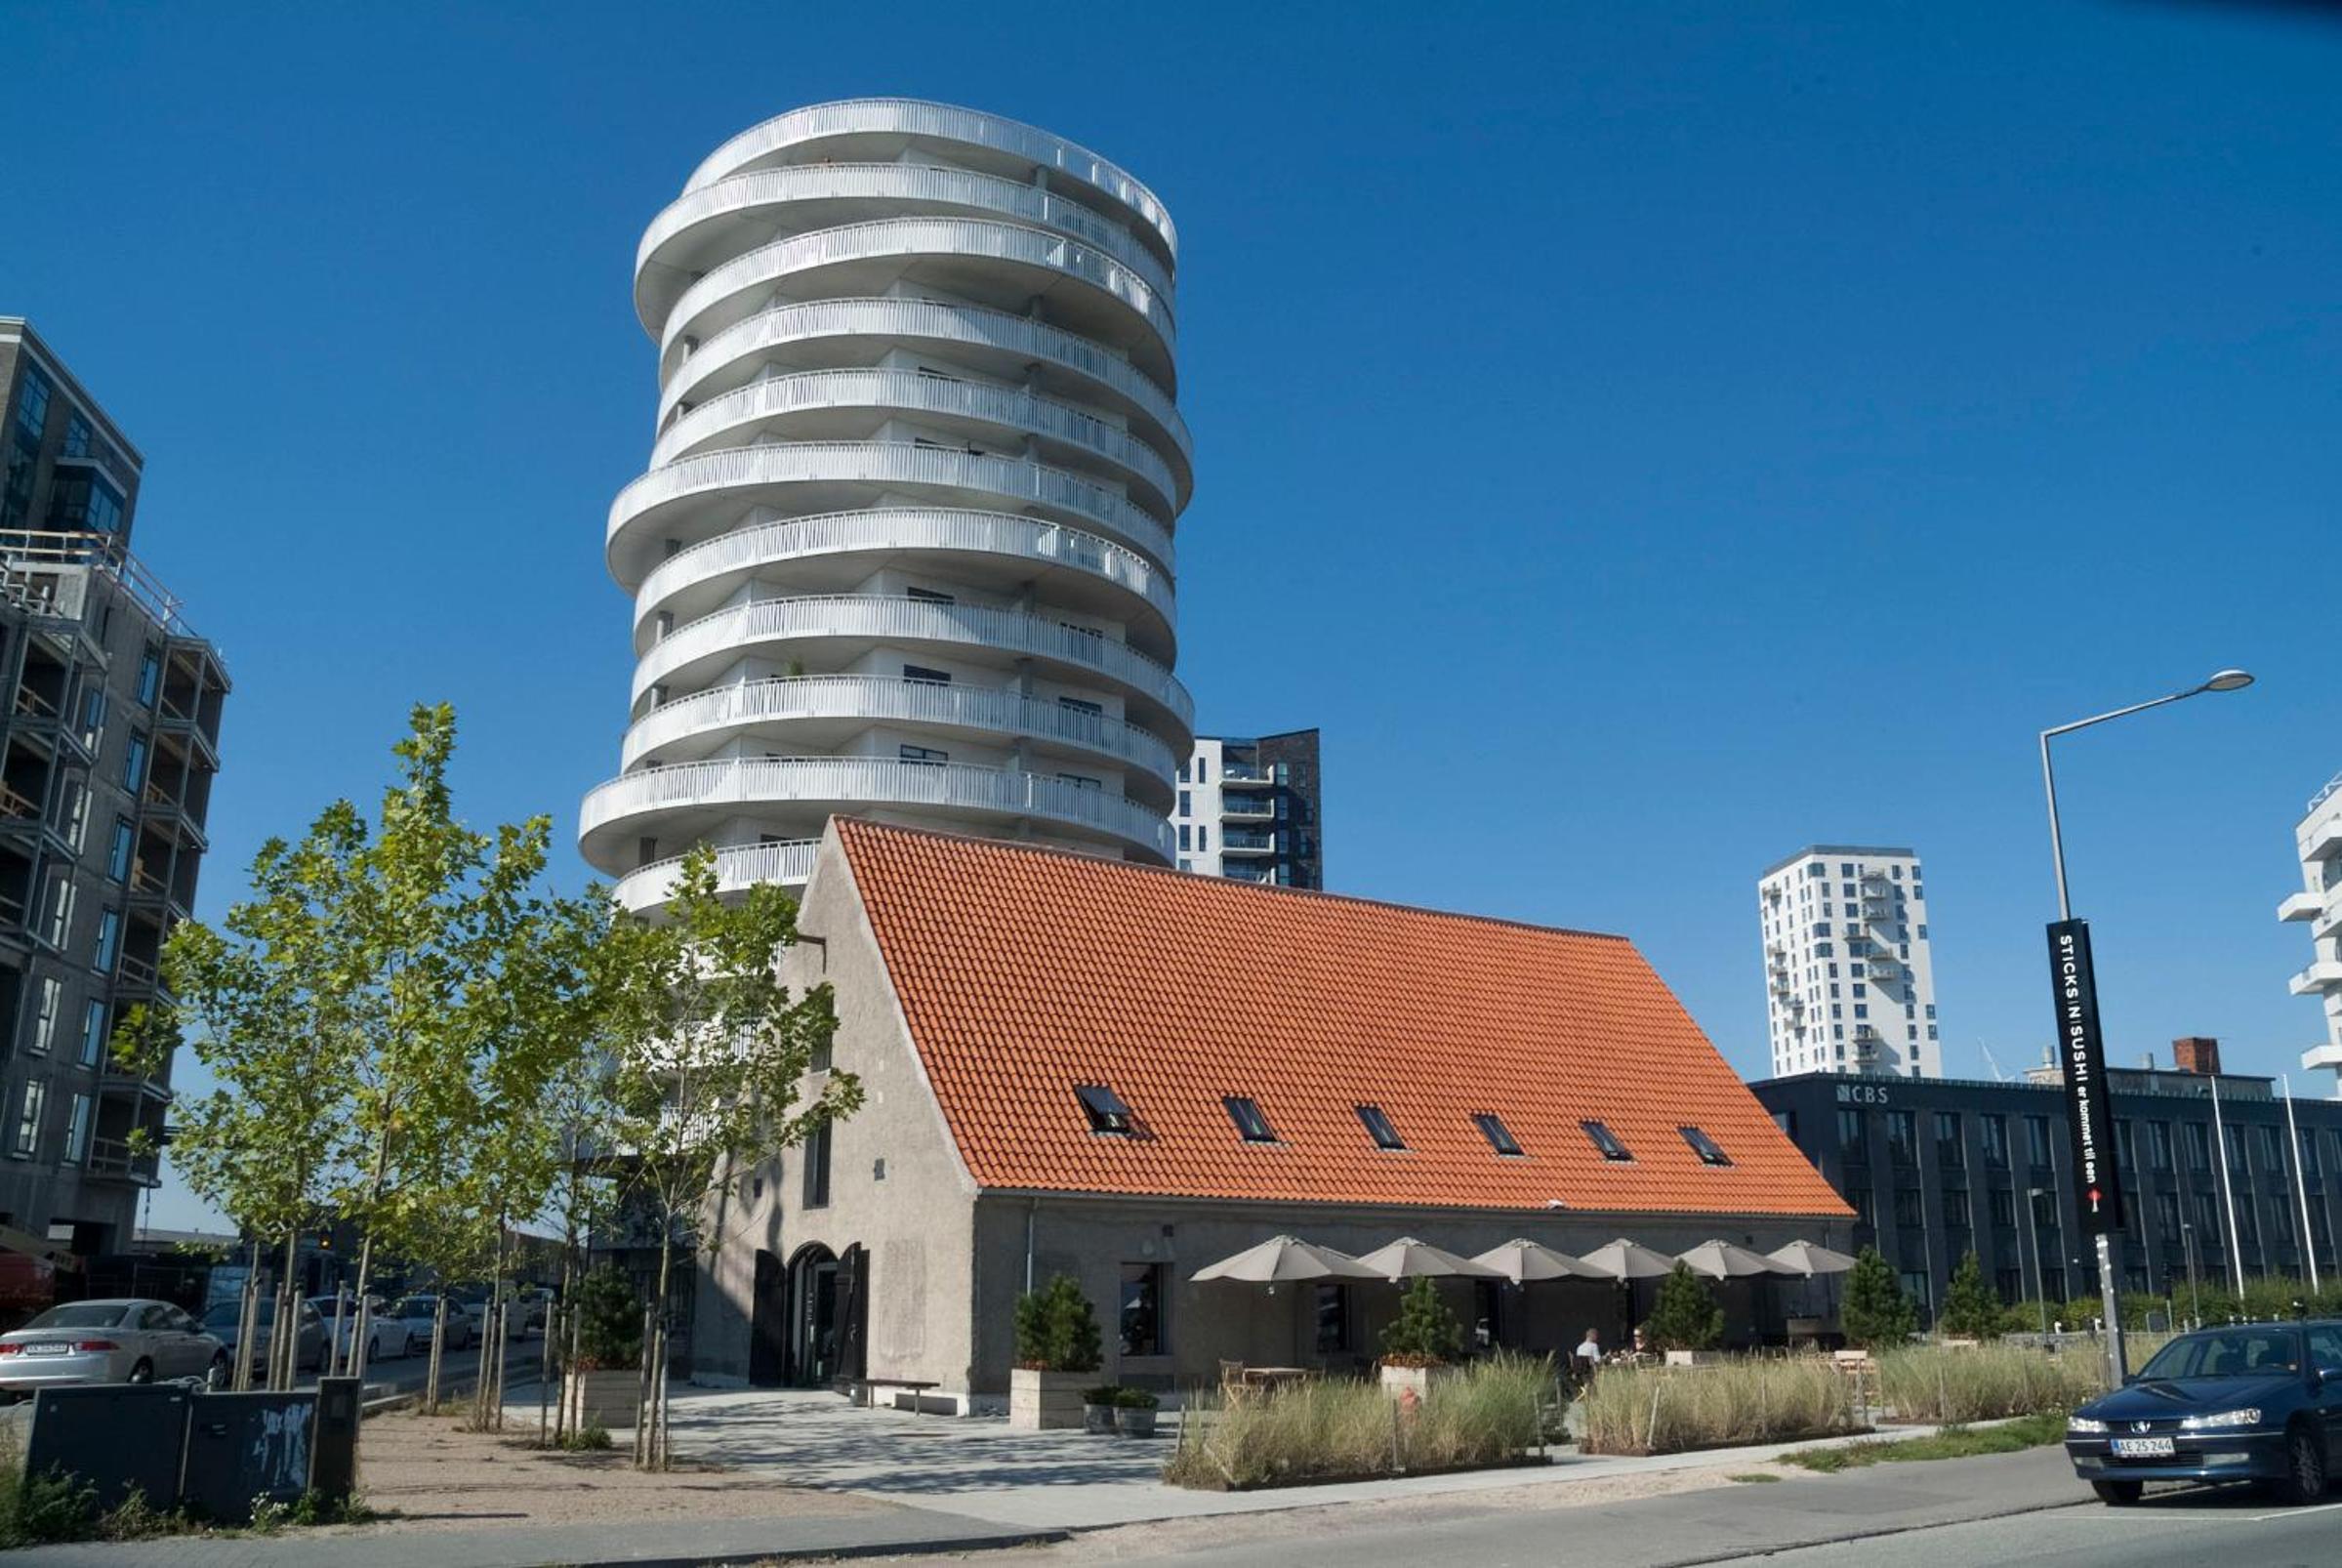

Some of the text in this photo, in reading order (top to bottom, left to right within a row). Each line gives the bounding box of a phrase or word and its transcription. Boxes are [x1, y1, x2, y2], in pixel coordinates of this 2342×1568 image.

[1851, 1086, 1888, 1103] CBS
[2077, 1086, 2087, 1098] er
[2078, 1098, 2092, 1146] kommet
[2084, 1147, 2096, 1160] til
